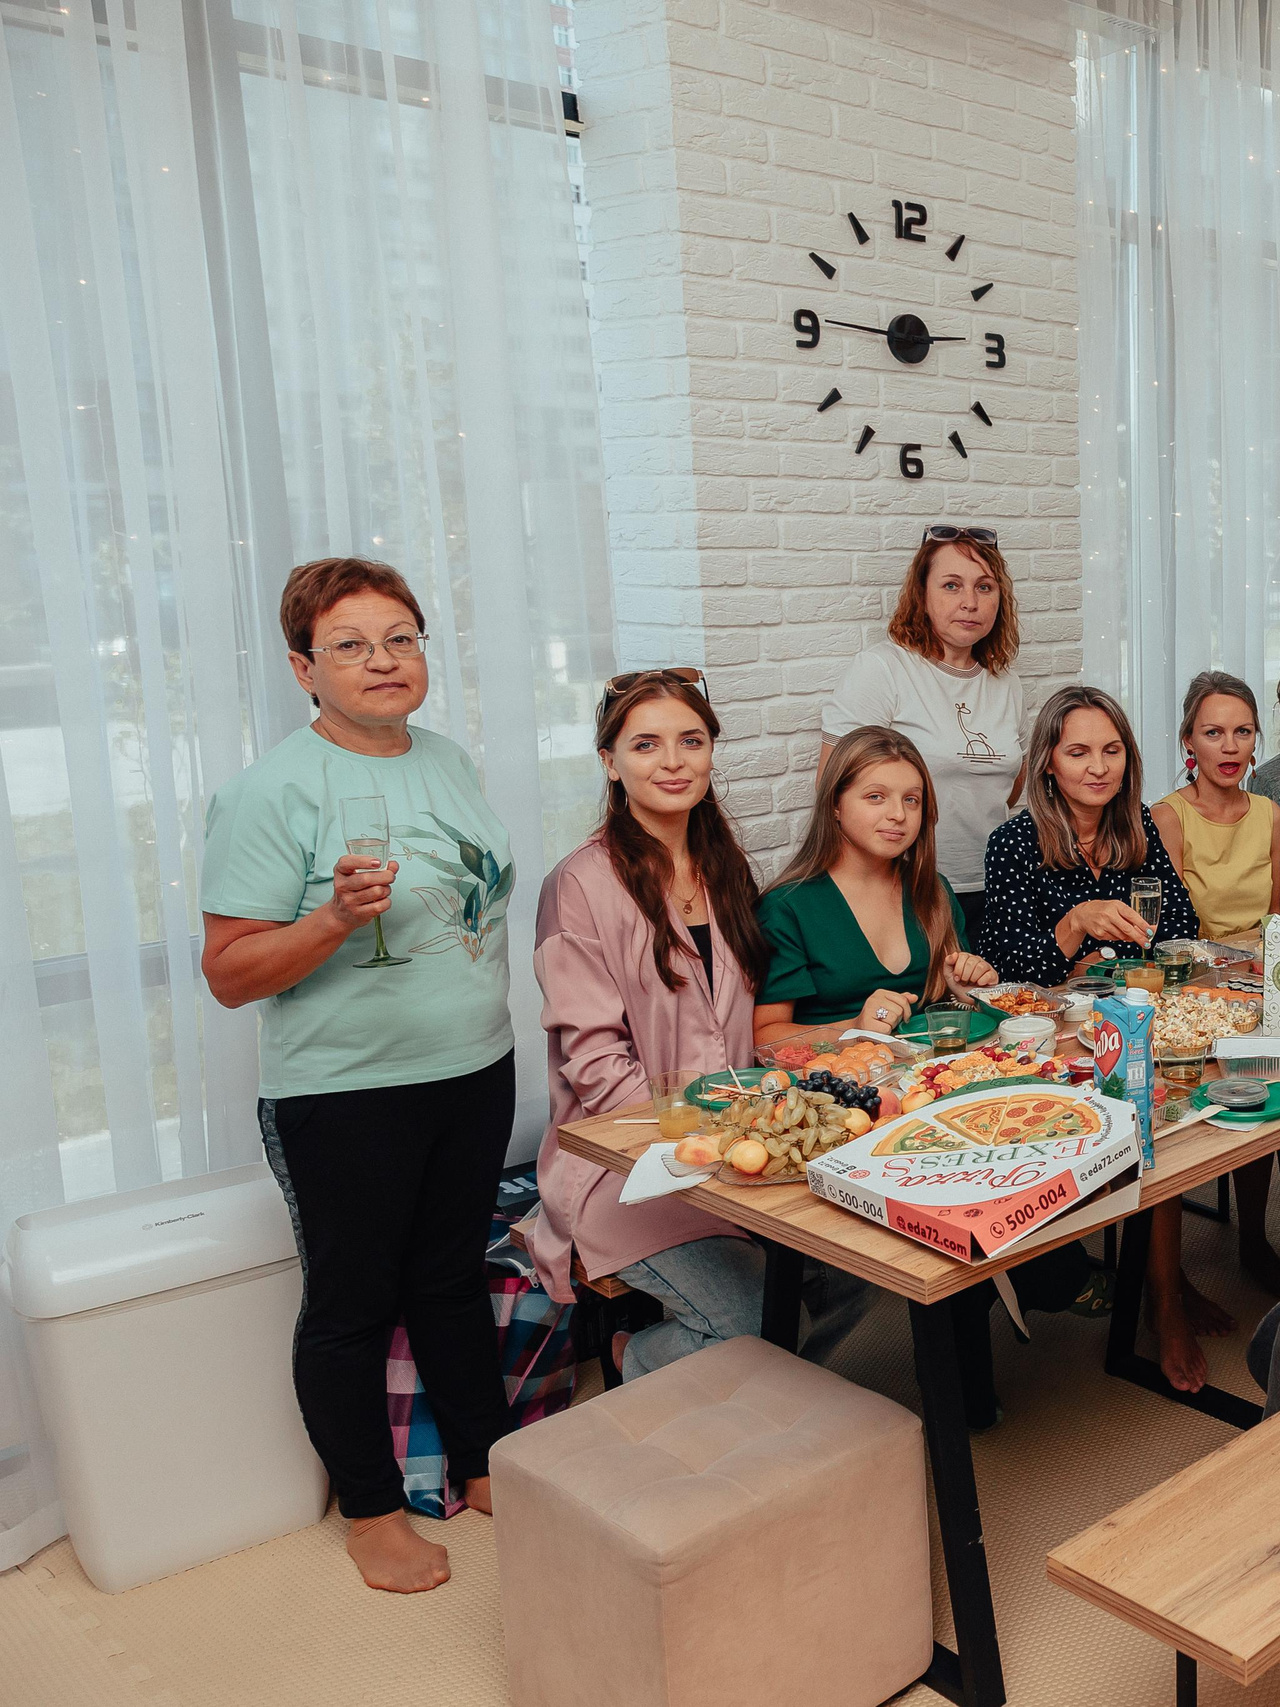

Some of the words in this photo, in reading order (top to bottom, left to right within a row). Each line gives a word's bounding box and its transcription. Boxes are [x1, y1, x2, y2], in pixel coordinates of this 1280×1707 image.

[892, 199, 928, 243] 12
[793, 308, 821, 349] 9
[985, 332, 1006, 369] 3
[900, 442, 924, 480] 6
[882, 1136, 1094, 1178] EXPRESS
[895, 1161, 1047, 1190] Pizza
[1088, 1144, 1132, 1177] eda72.com
[155, 1211, 205, 1226] Kimberly-Clark
[838, 1189, 884, 1220] 500-004
[1005, 1183, 1067, 1231] 500-004
[907, 1222, 968, 1256] eda72.com
